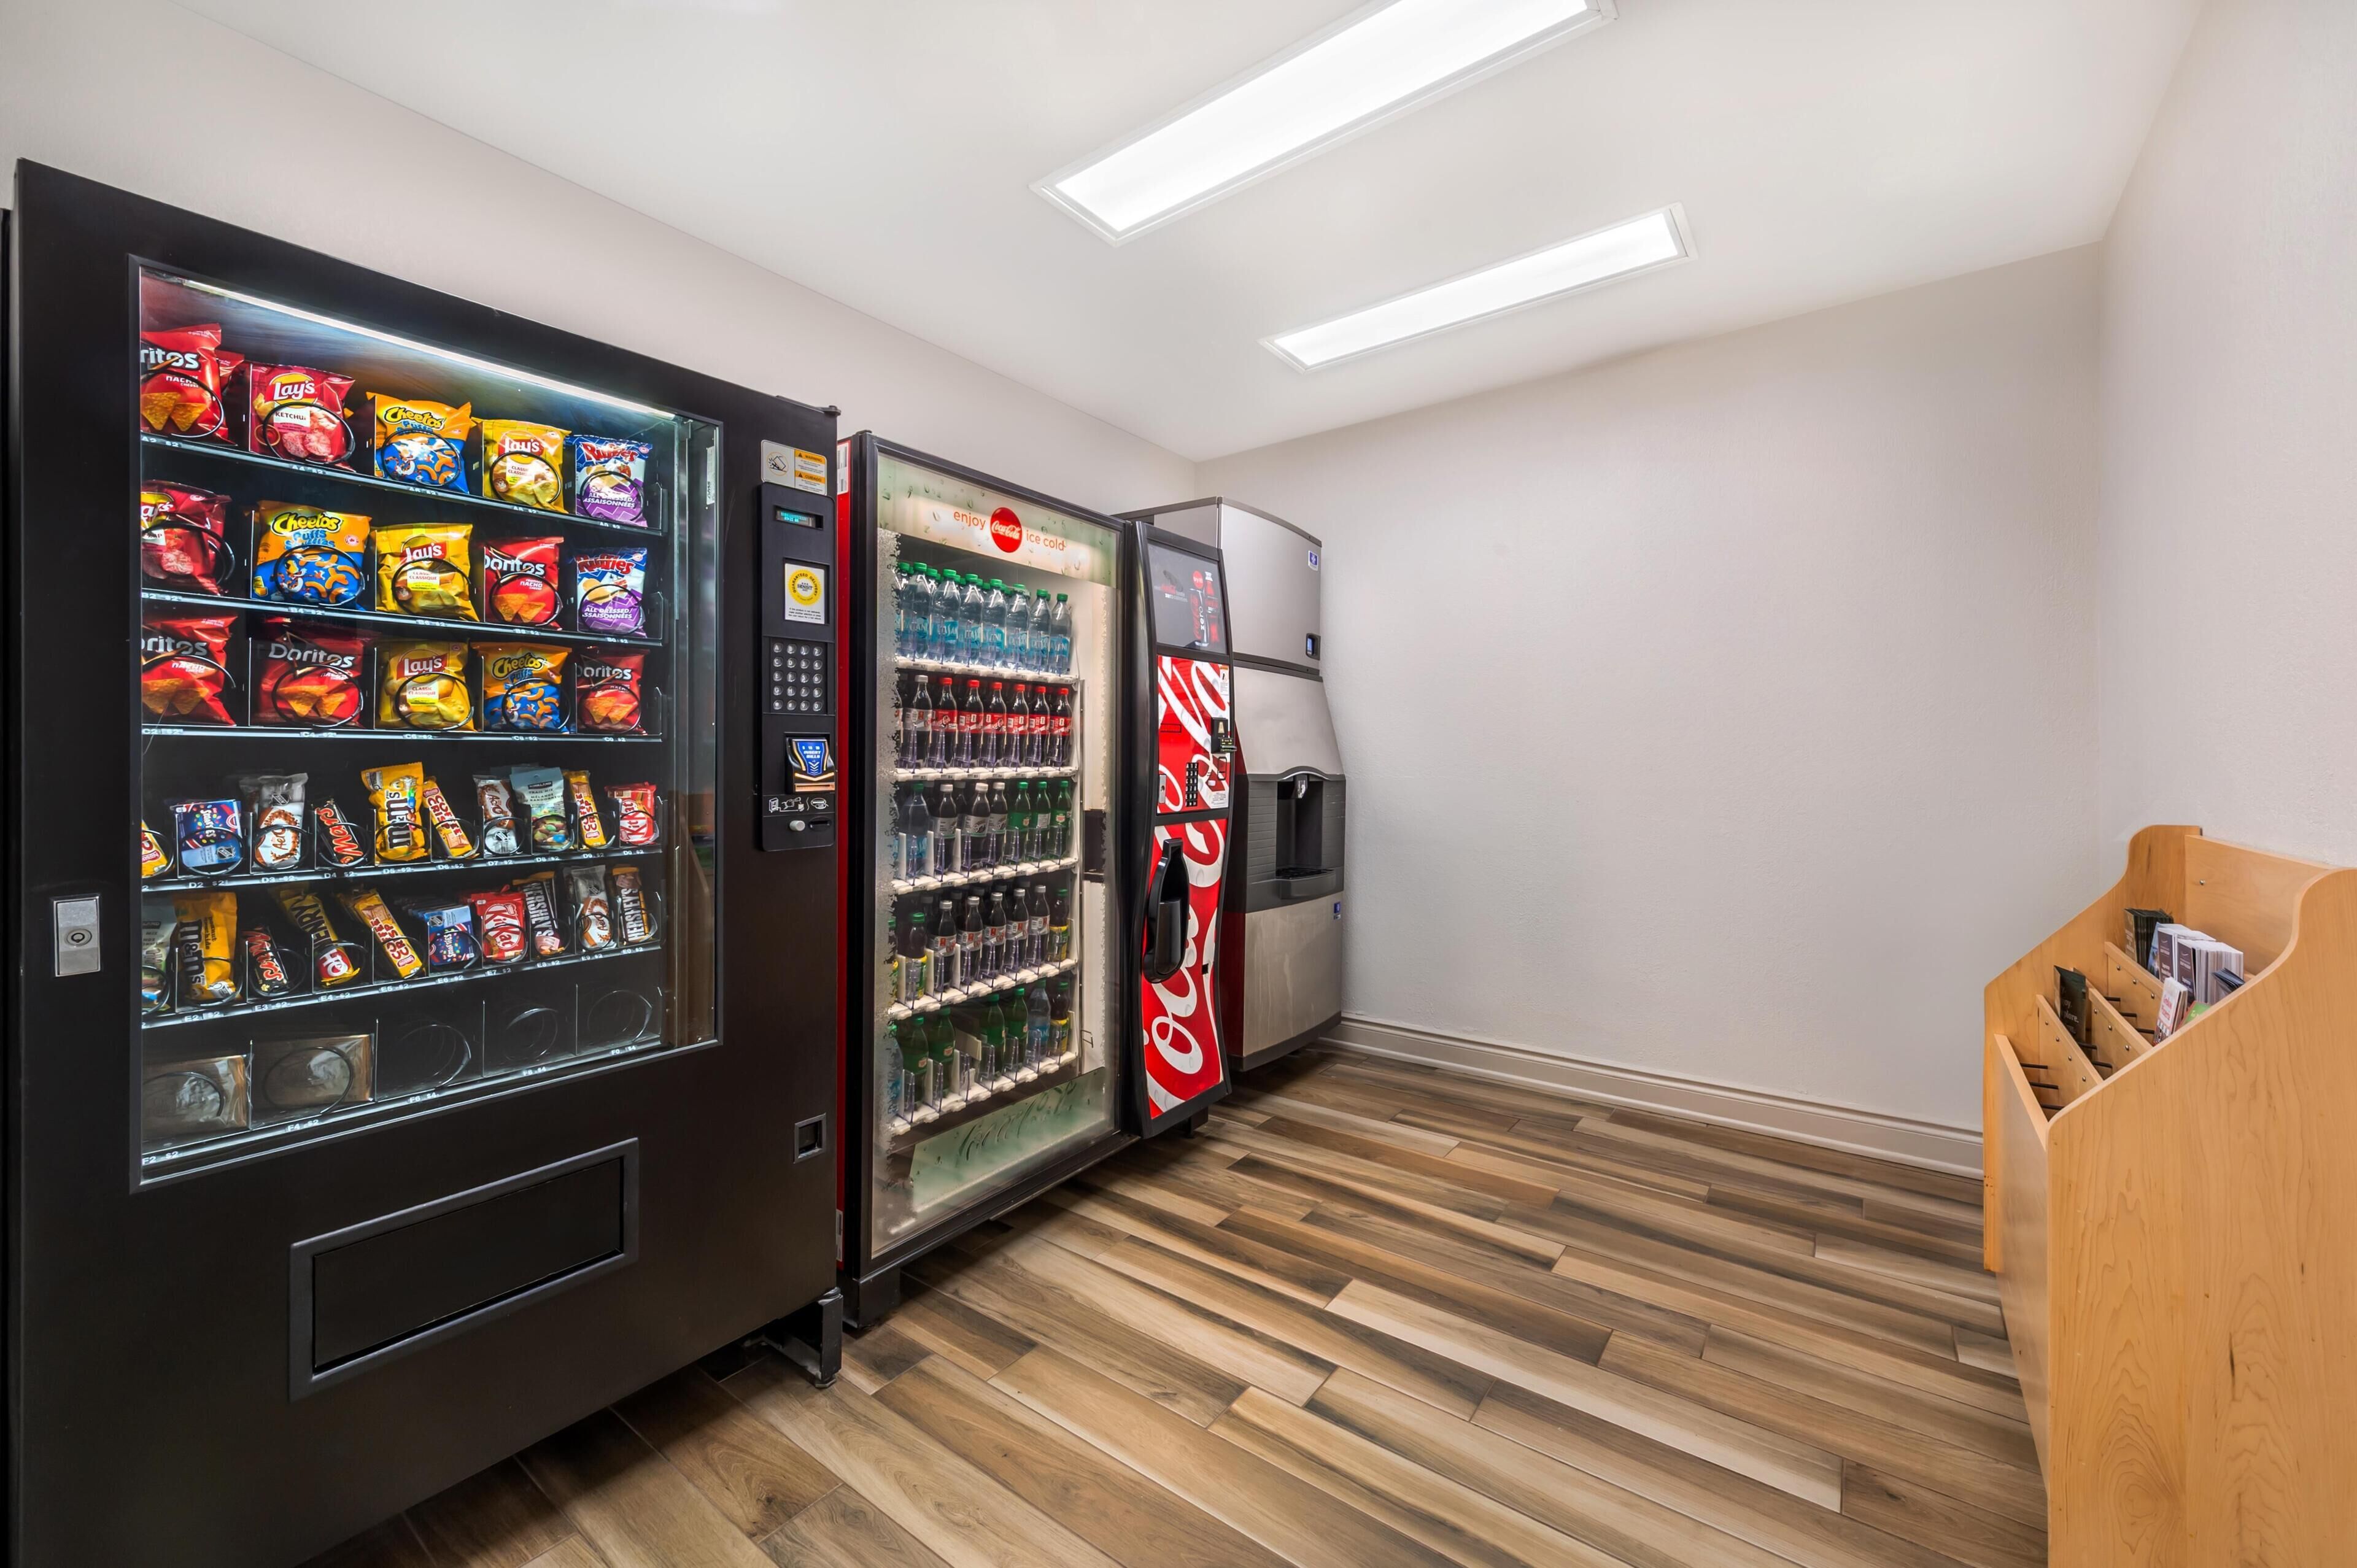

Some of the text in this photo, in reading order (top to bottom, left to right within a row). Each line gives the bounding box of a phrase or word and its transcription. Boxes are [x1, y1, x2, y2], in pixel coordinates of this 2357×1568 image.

[141, 347, 199, 369] ritos
[274, 380, 315, 400] Lay's
[384, 407, 446, 428] Cheetos
[273, 512, 341, 535] Cheetos
[953, 511, 1066, 551] enjoy Coca-Cola ice cold
[406, 543, 443, 565] Lay's
[576, 554, 635, 575] Ruffles
[792, 573, 818, 596] GUARANTEED DELIVERY
[269, 643, 355, 668] Doritos
[404, 657, 443, 676] Lay's
[492, 653, 544, 679] Cheetos
[621, 887, 646, 941] HERSHEY'S
[142, 1156, 157, 1165] F2
